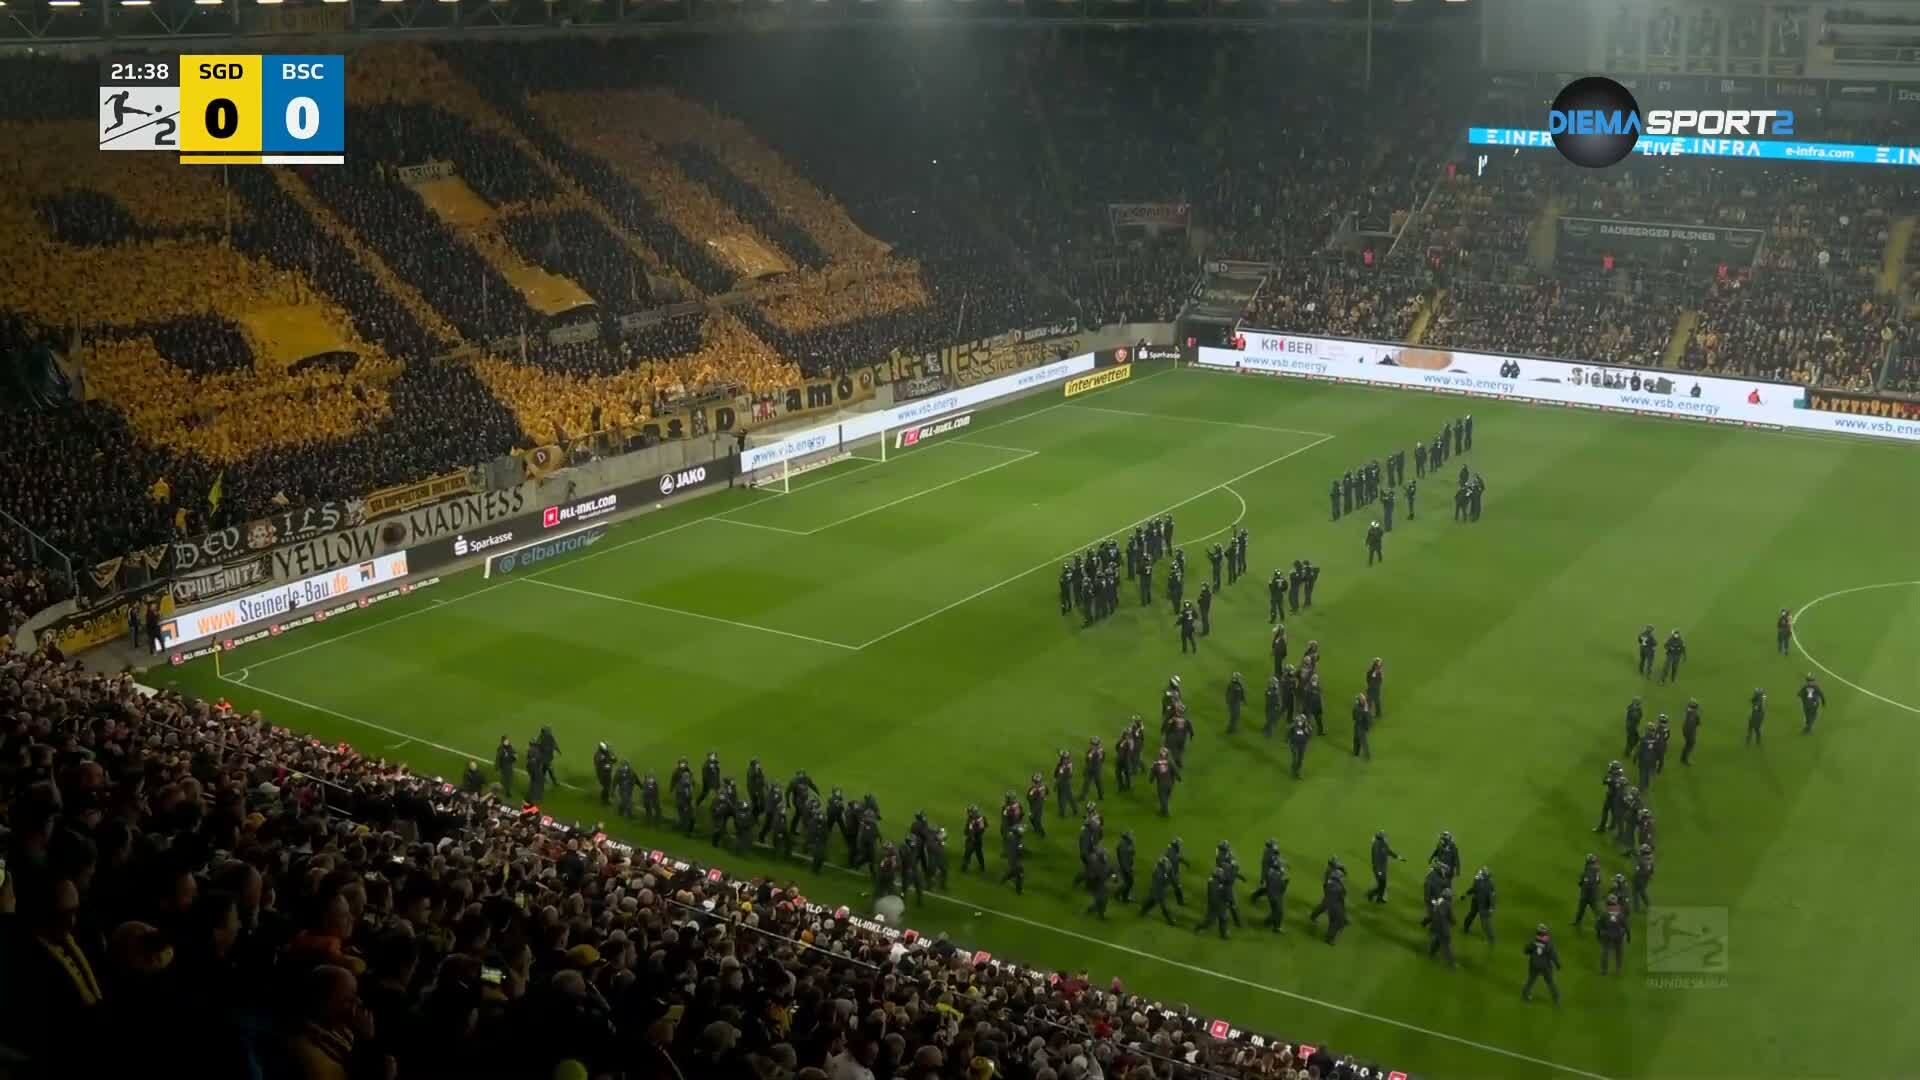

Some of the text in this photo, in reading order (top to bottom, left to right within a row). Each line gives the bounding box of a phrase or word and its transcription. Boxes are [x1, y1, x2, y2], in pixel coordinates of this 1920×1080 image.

[1486, 129, 1551, 147] E.INFR
[1785, 145, 1855, 159] e-infra.com
[1600, 225, 1670, 239] RADEBERGER
[1671, 230, 1716, 242] PILSNER
[1243, 355, 1327, 373] www.vsb.energy
[1067, 368, 1128, 395] interwetten
[1423, 373, 1515, 393] www.vsb.energy
[898, 396, 958, 421] www.vsb.energy
[1620, 393, 1720, 416] www.vsb.energy
[675, 467, 707, 489] JAKO
[275, 525, 381, 579] YELLOW
[409, 483, 525, 543] MADNESS
[469, 531, 513, 552] Sparkasse
